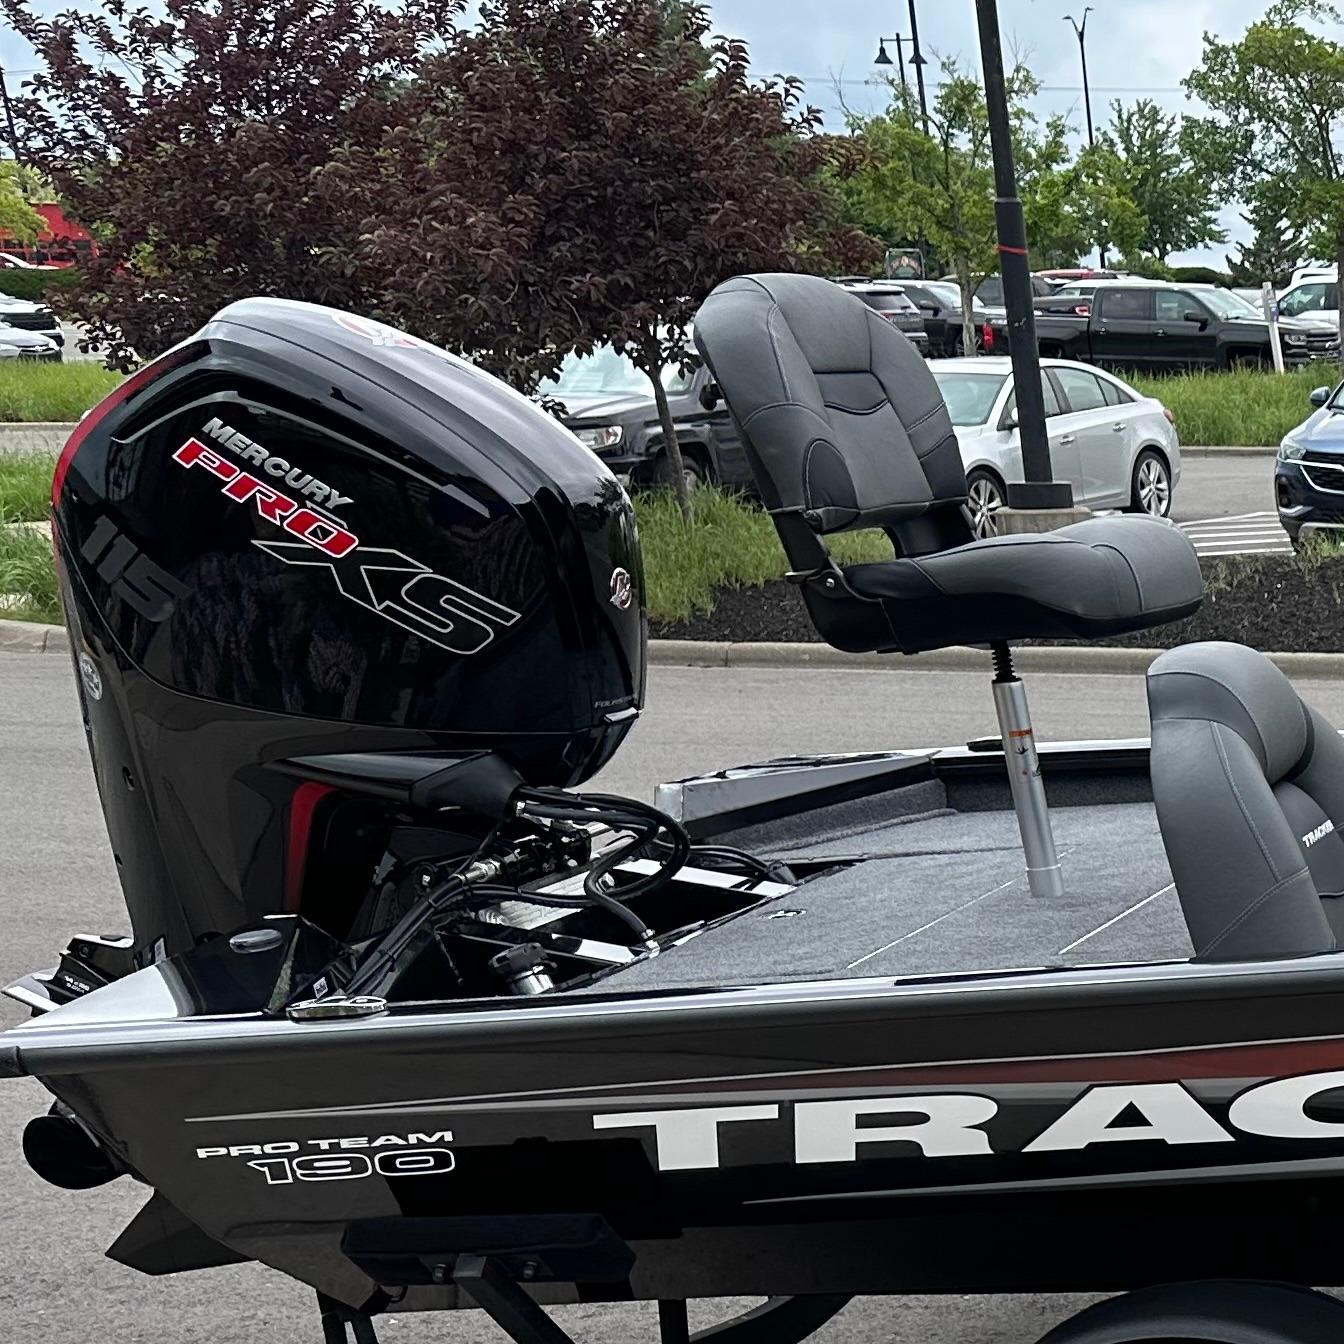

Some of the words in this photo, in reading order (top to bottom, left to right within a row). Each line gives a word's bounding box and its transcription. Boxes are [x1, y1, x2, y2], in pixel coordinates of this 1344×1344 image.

[173, 437, 359, 558] PRO
[201, 416, 354, 509] MERCURY
[80, 514, 193, 622] 115
[250, 539, 522, 655] XS
[196, 1141, 300, 1159] PRO
[307, 1129, 455, 1151] TEAM
[246, 1147, 456, 1185] 190
